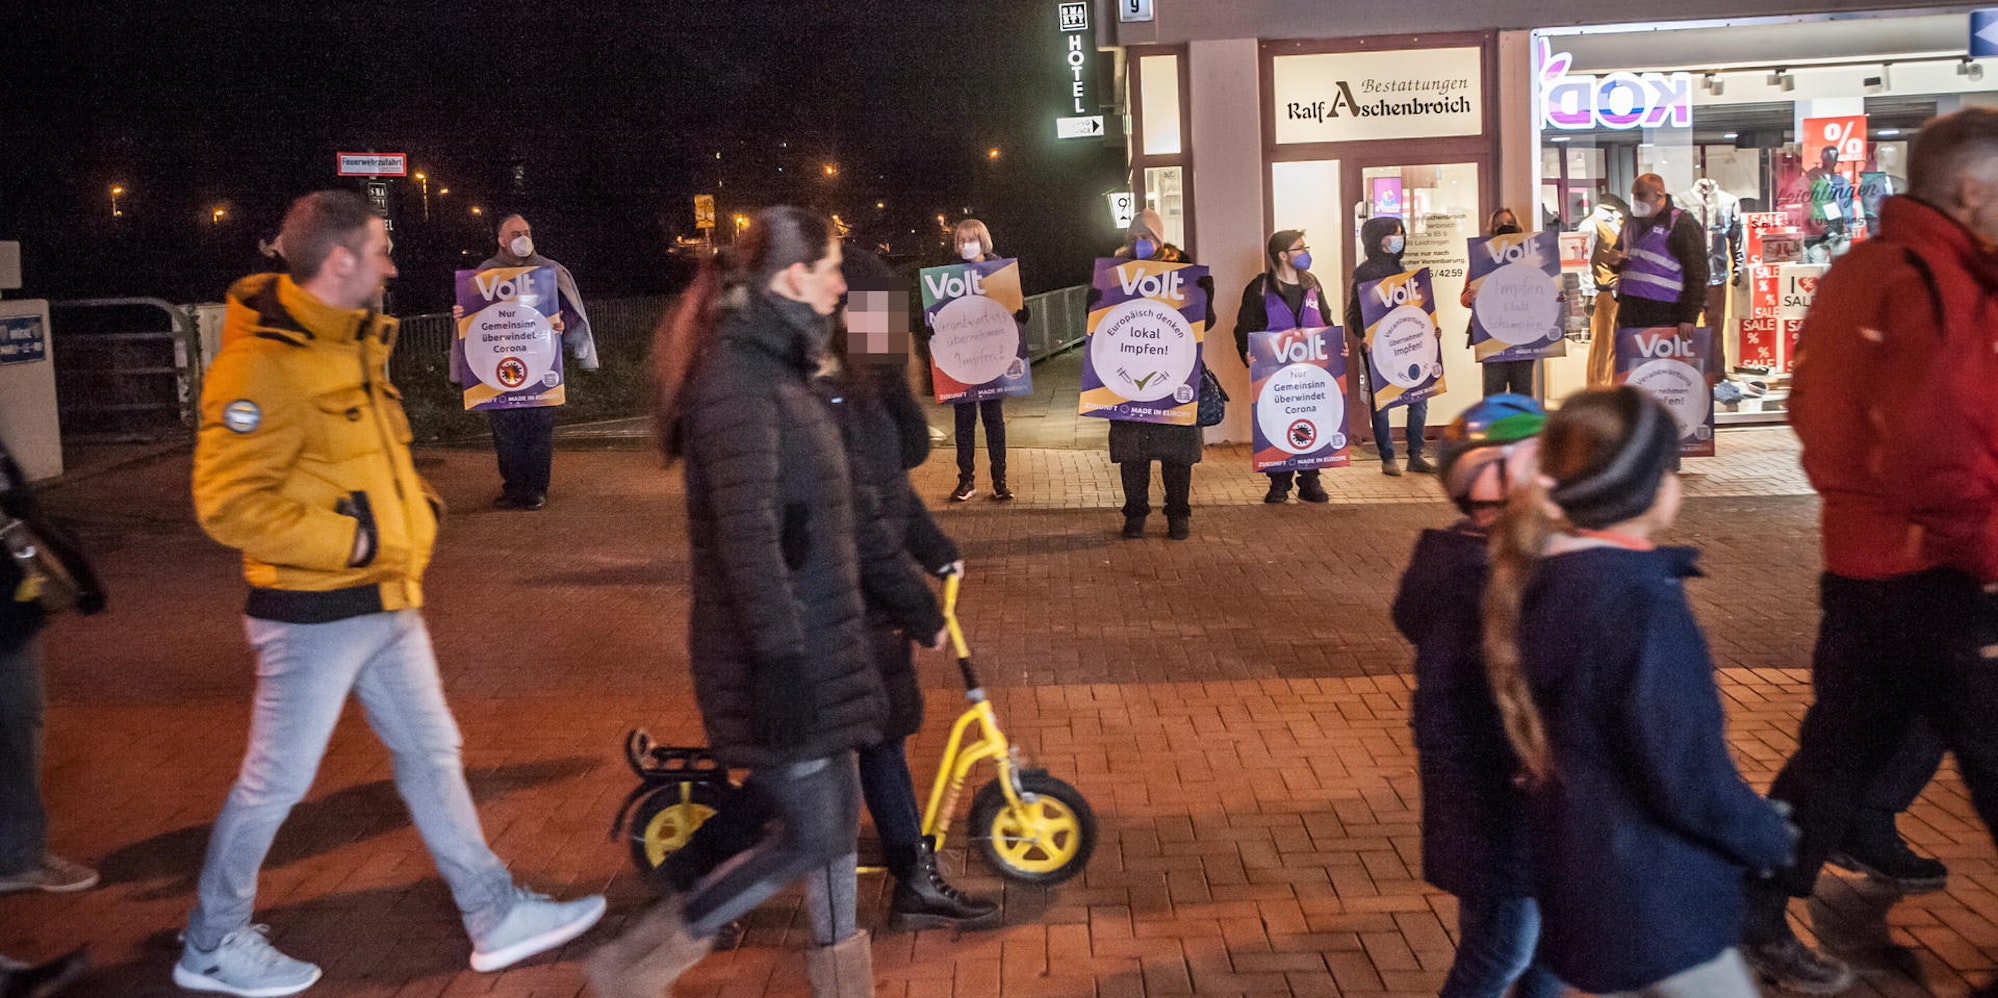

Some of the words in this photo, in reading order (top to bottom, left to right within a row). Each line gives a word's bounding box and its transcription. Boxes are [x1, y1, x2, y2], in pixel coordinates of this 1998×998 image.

[1067, 34, 1085, 113] HOTEL
[1361, 78, 1468, 95] Bestattungen
[1287, 102, 1325, 123] Ralf
[1327, 81, 1471, 117] Aschenbroich
[1485, 239, 1542, 264] Volt
[474, 274, 536, 301] Volt
[924, 270, 987, 299] Volt
[1117, 266, 1184, 300] Volt
[1374, 277, 1422, 308] Volt
[481, 321, 536, 331] Gemeinsinn
[1107, 309, 1154, 337] Europäisch
[1156, 312, 1184, 339] denken
[1743, 319, 1775, 331] SALE
[1130, 327, 1160, 339] lokal
[493, 345, 527, 353] Corona
[1120, 343, 1168, 356] Impfen!
[1269, 334, 1328, 363] Volt
[1634, 333, 1695, 357] Volt
[1290, 371, 1307, 379] Nur
[1274, 381, 1325, 392] Gemeinsinn
[1274, 392, 1325, 403] überwindet
[1131, 407, 1151, 415] MADE
[1285, 405, 1317, 414] Corona
